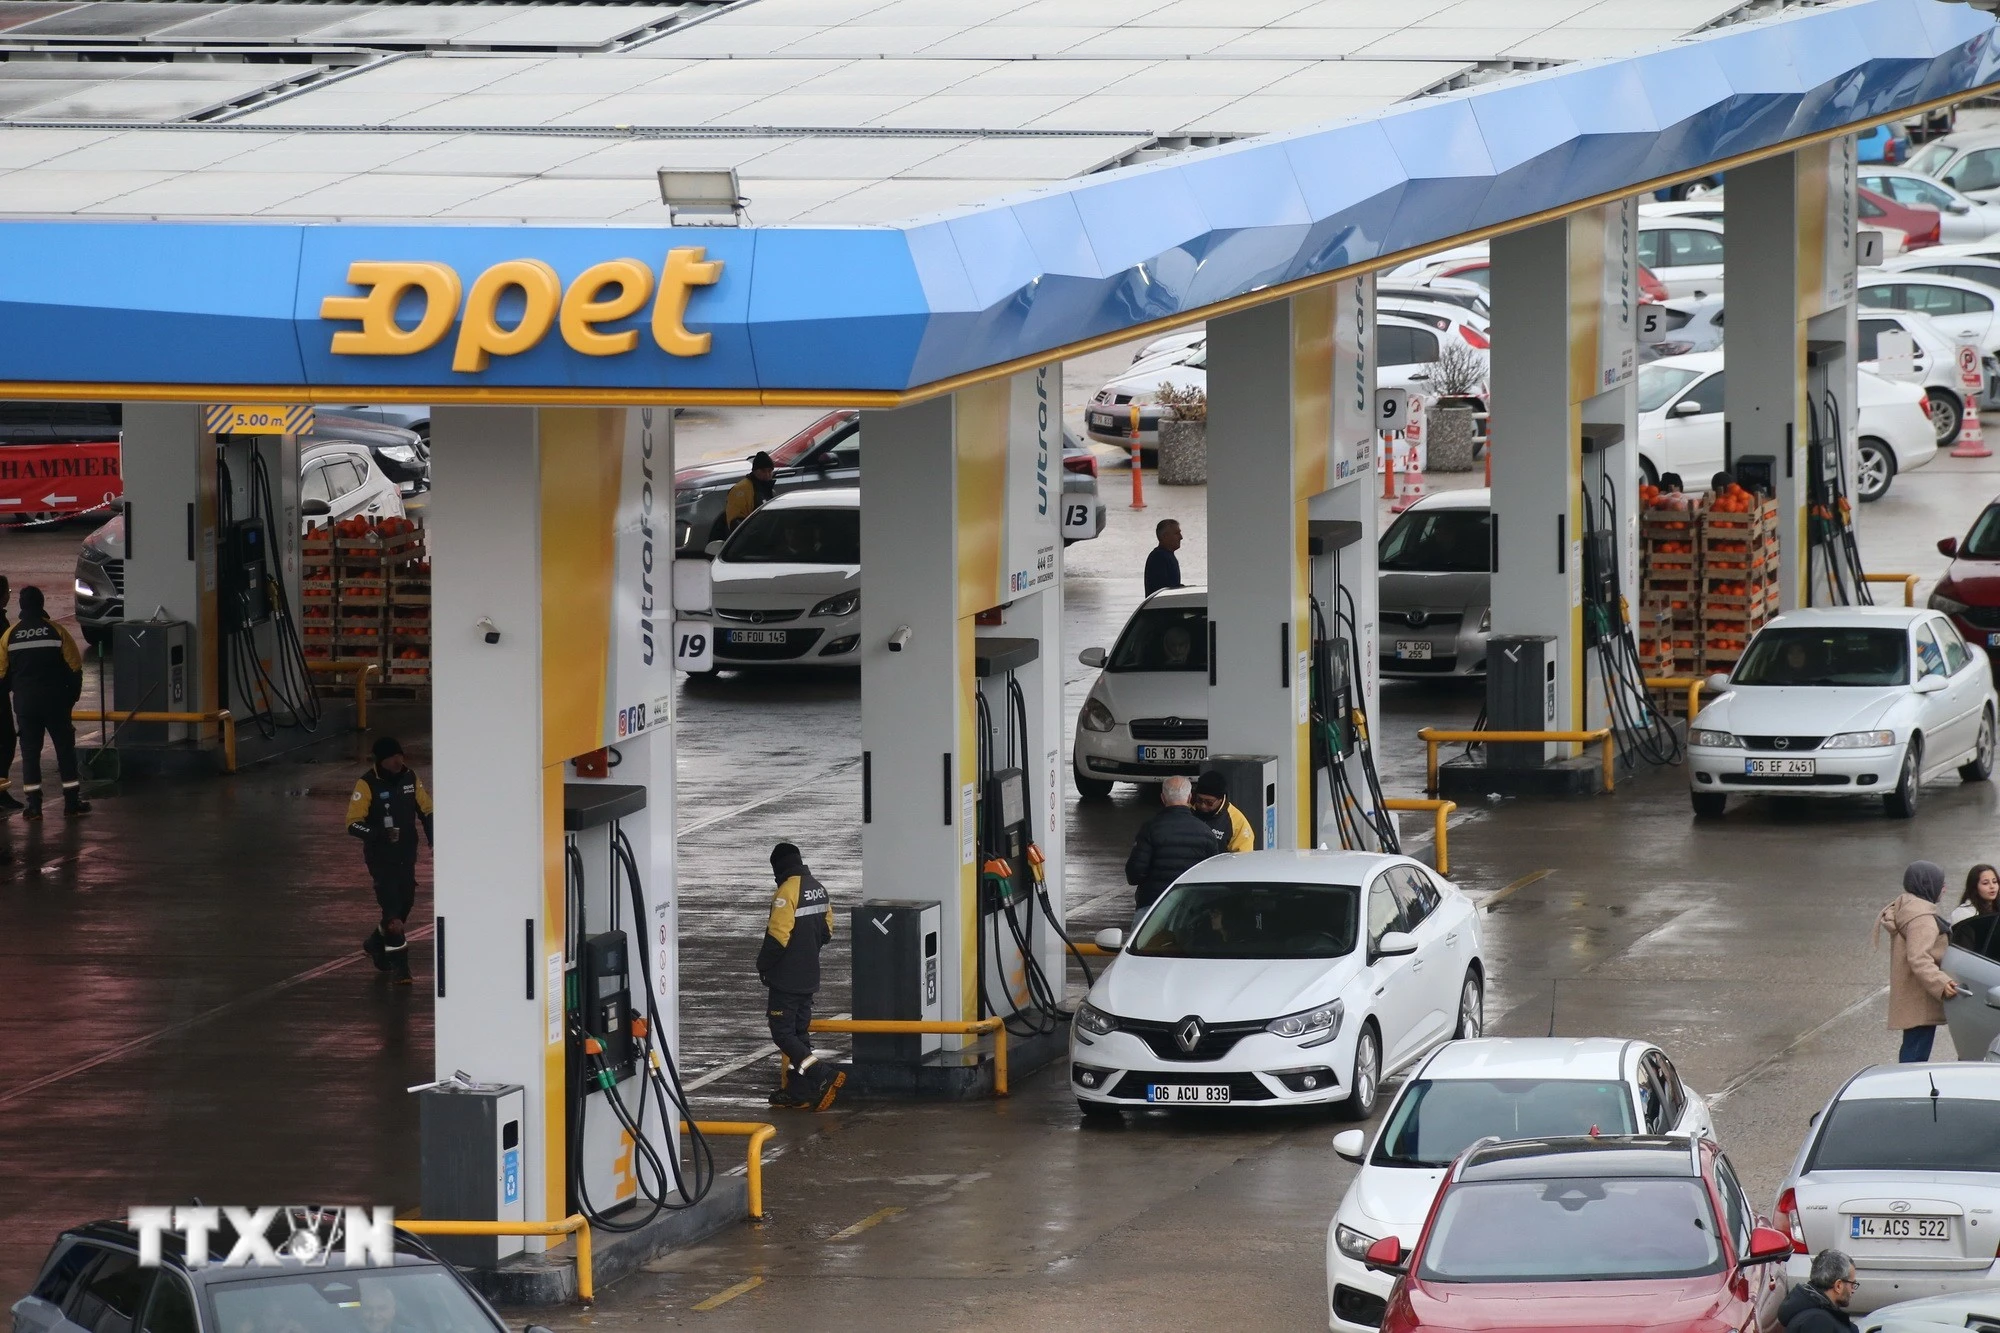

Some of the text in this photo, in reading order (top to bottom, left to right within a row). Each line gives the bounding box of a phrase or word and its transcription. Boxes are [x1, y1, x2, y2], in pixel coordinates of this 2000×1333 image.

[319, 246, 724, 373] opet
[1643, 314, 1657, 332] 5
[1383, 399, 1397, 418] 9
[236, 413, 268, 426] 5.00
[1, 457, 118, 479] HAMMER
[1065, 504, 1088, 526] 13
[15, 626, 49, 639] opet
[732, 631, 743, 642] 06
[769, 632, 785, 643] 145
[678, 634, 706, 658] 19
[1397, 642, 1408, 650] 34
[1408, 650, 1423, 659] 255
[1145, 747, 1205, 760] 06 KB 3670
[1752, 760, 1812, 773] 06 EF 2451
[804, 887, 826, 902] opet
[1155, 1086, 1169, 1100] 06
[1177, 1086, 1199, 1101] ACU
[1206, 1087, 1229, 1101] 839
[1861, 1219, 1946, 1237] 14 ACS 522
